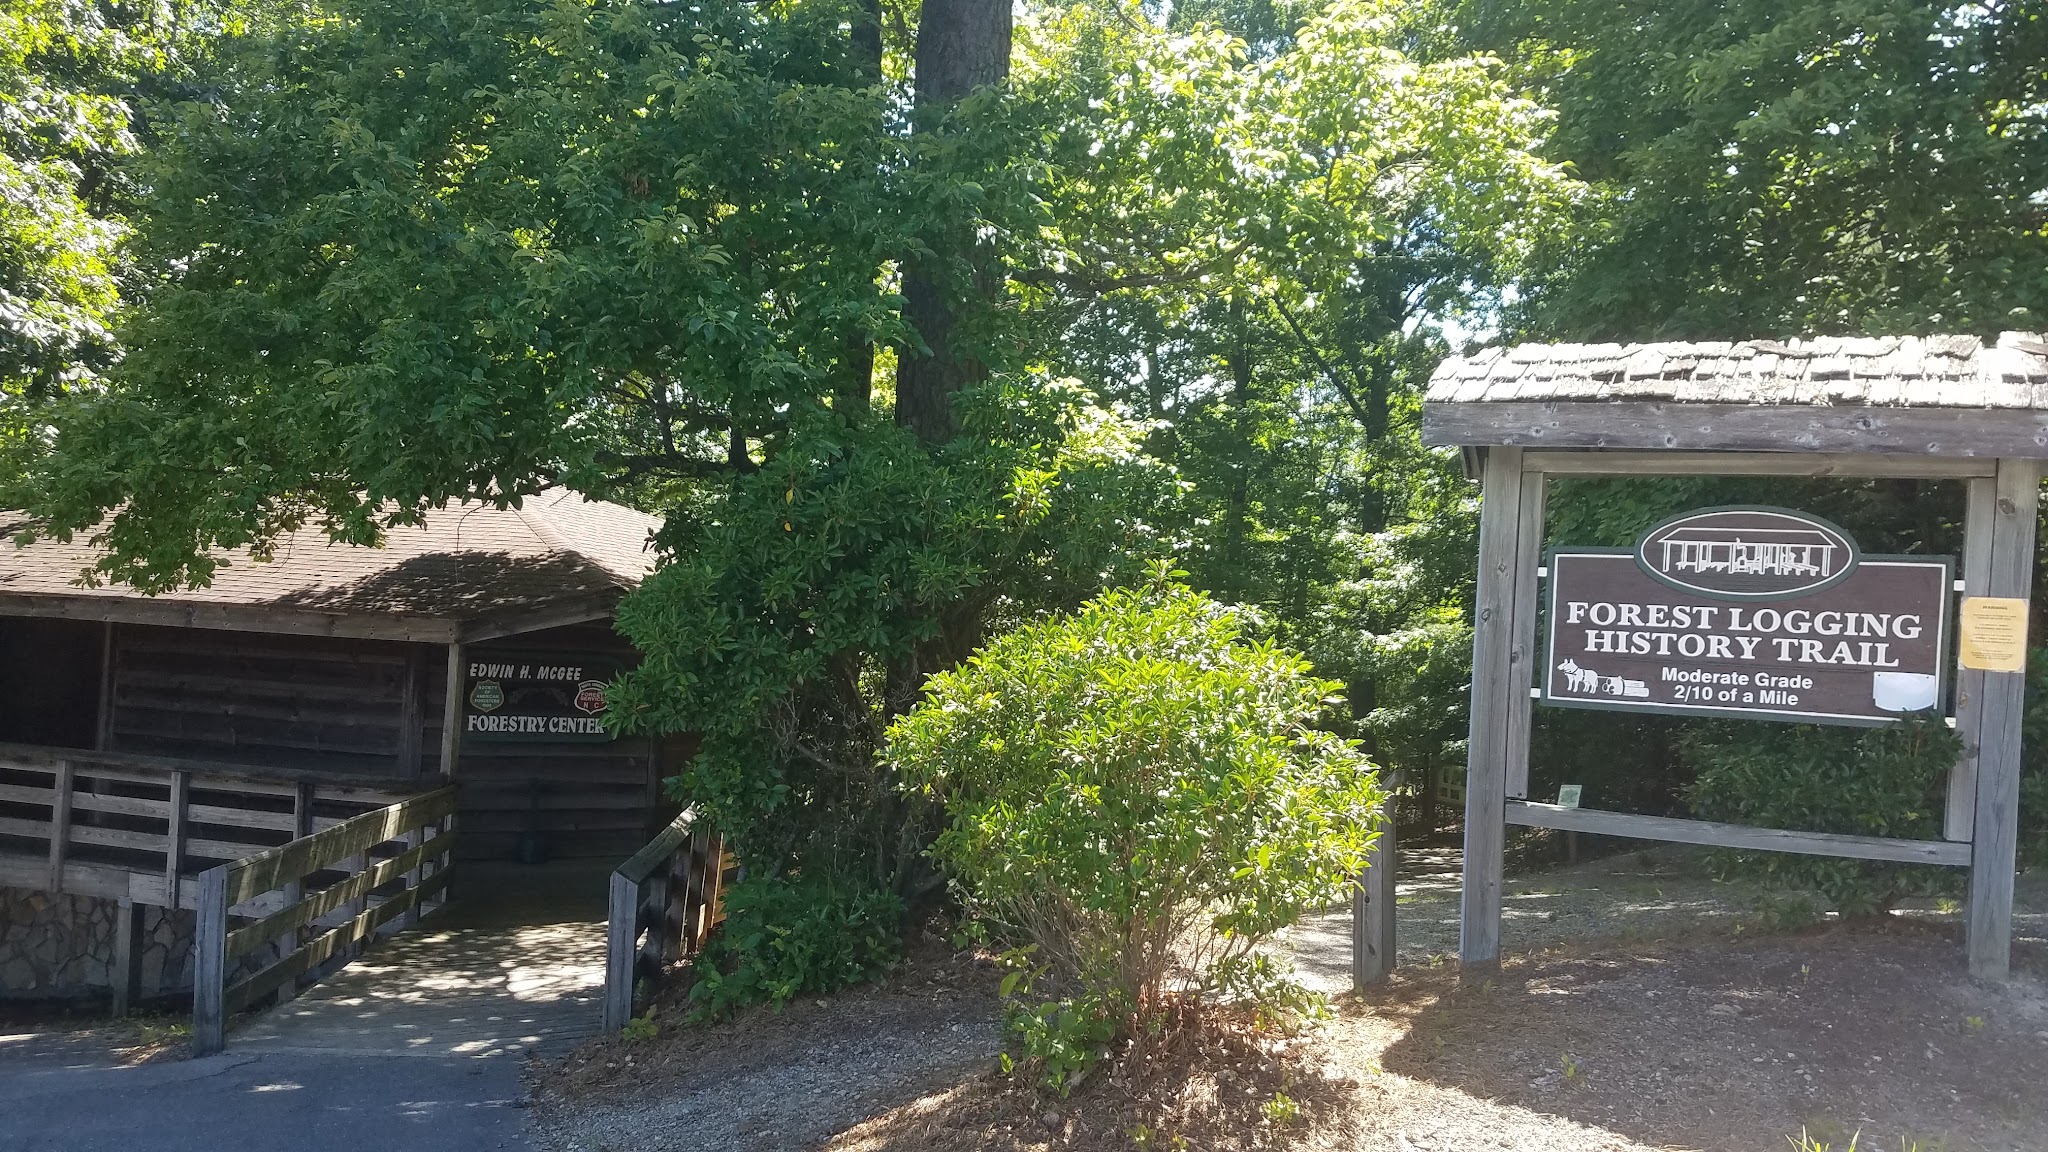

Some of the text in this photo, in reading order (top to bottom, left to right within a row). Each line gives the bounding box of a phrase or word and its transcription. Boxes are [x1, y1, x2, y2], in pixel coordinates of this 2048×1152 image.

[1566, 601, 1923, 639] FOREST LOGGING
[1584, 629, 1900, 667] HISTORY TRAIL
[469, 663, 583, 681] EDWIN H. MCGEE
[1661, 667, 1813, 689] Moderate Grade
[1674, 685, 1799, 706] 2/10 of a Mile
[467, 715, 548, 733] FORESTRY
